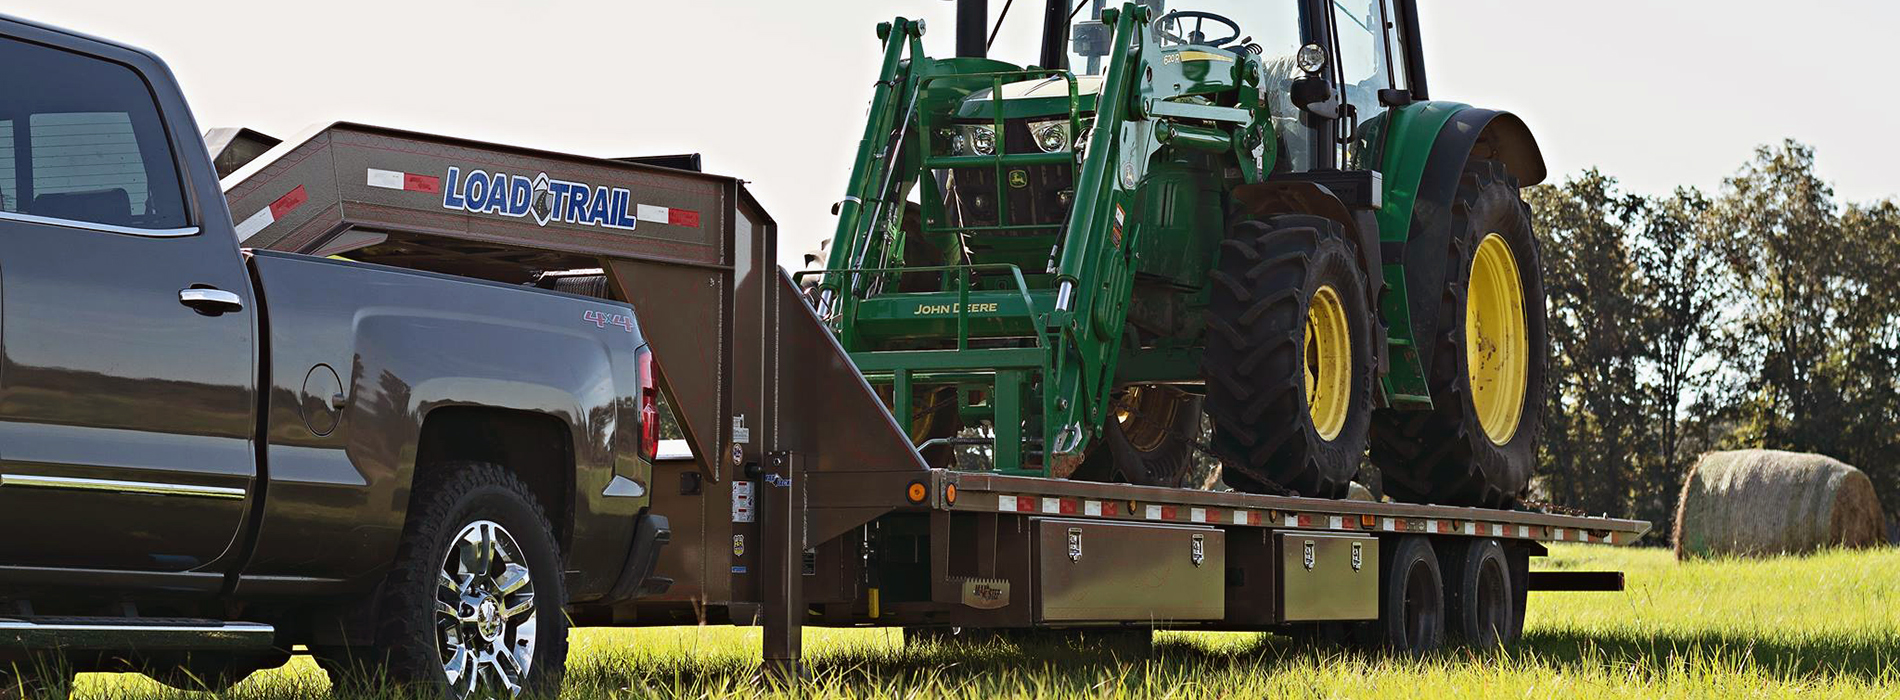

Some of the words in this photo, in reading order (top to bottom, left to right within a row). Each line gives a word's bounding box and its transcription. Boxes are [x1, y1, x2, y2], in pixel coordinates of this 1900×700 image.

[443, 166, 533, 217] LOAD
[547, 178, 637, 230] TRAIL
[914, 304, 950, 315] JOHN
